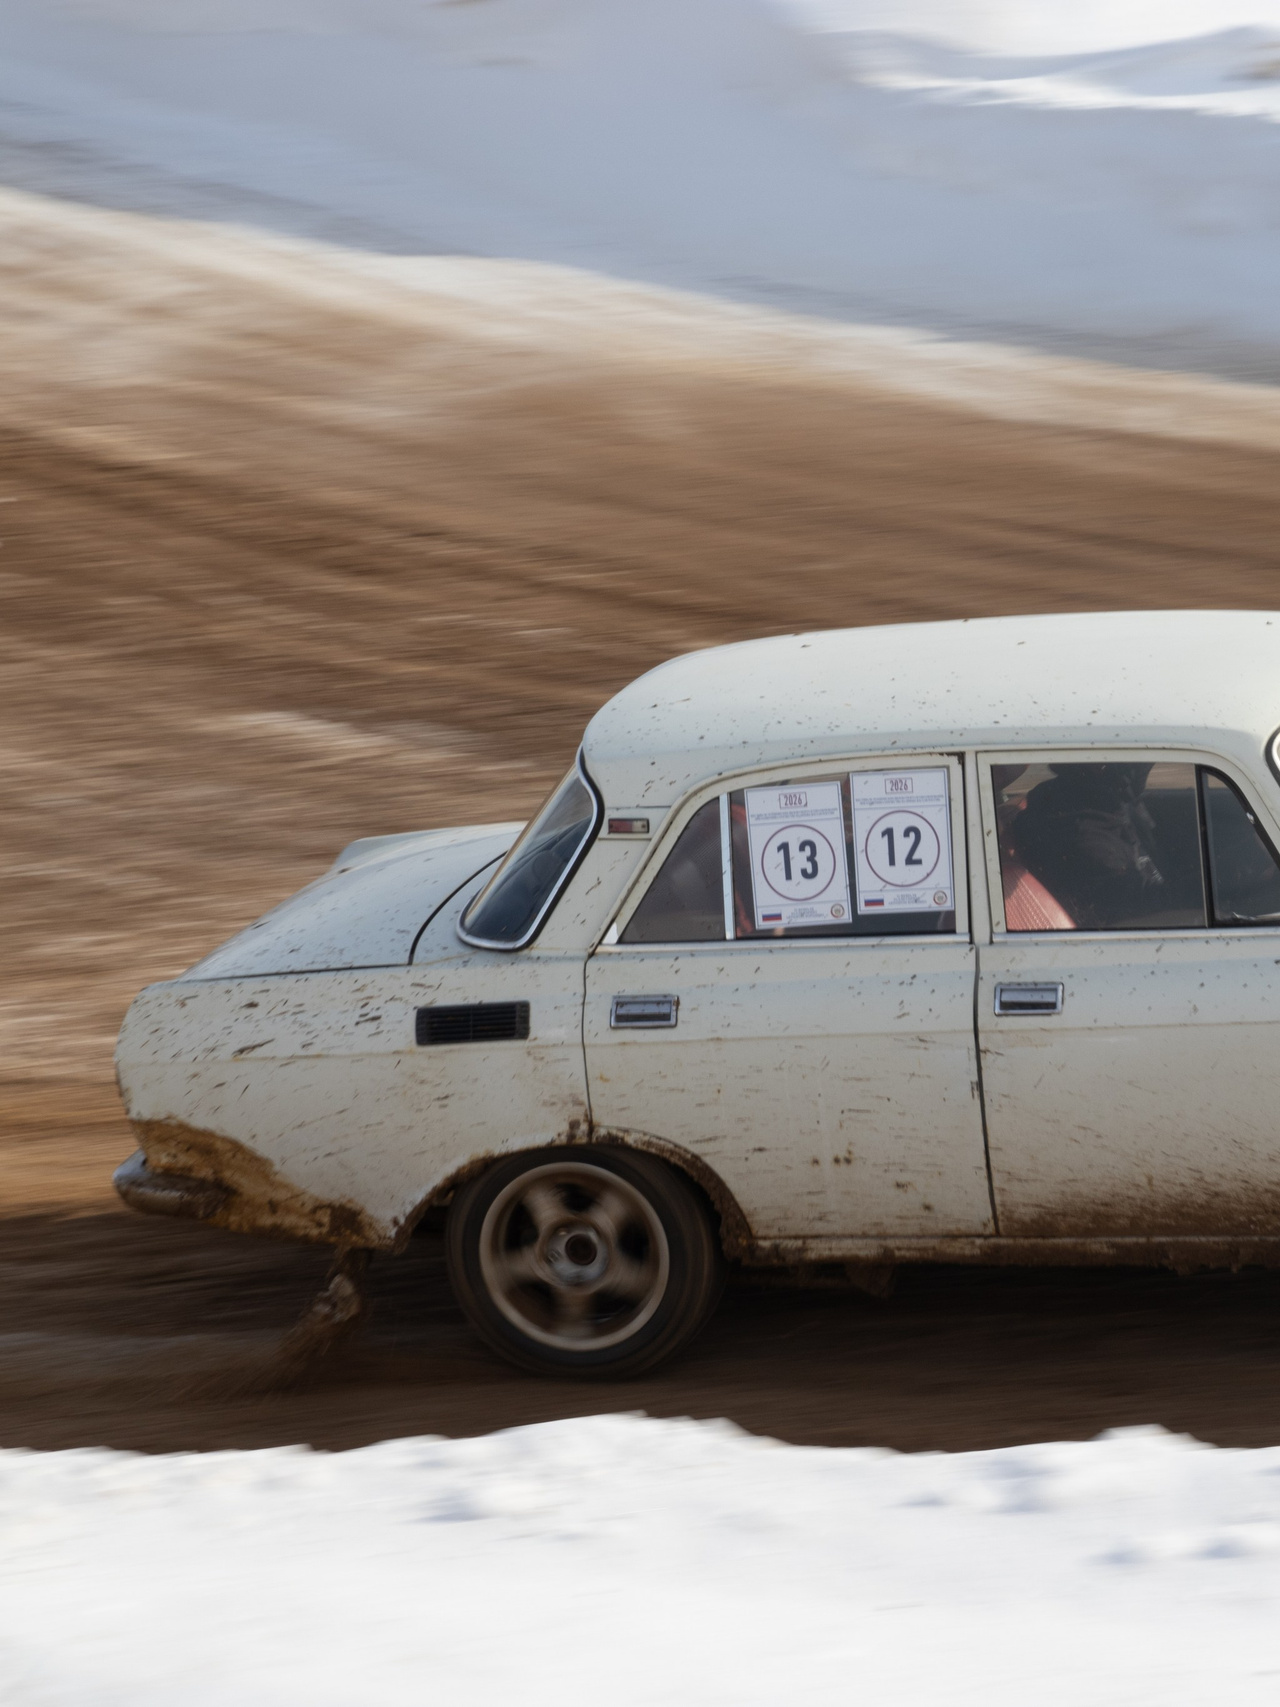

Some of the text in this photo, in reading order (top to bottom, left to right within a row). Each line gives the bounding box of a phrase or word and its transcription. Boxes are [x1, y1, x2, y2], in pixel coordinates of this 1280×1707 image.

[890, 779, 908, 792] 2026
[784, 794, 803, 806] 2026
[777, 839, 818, 881] 13
[881, 826, 922, 867] 12
